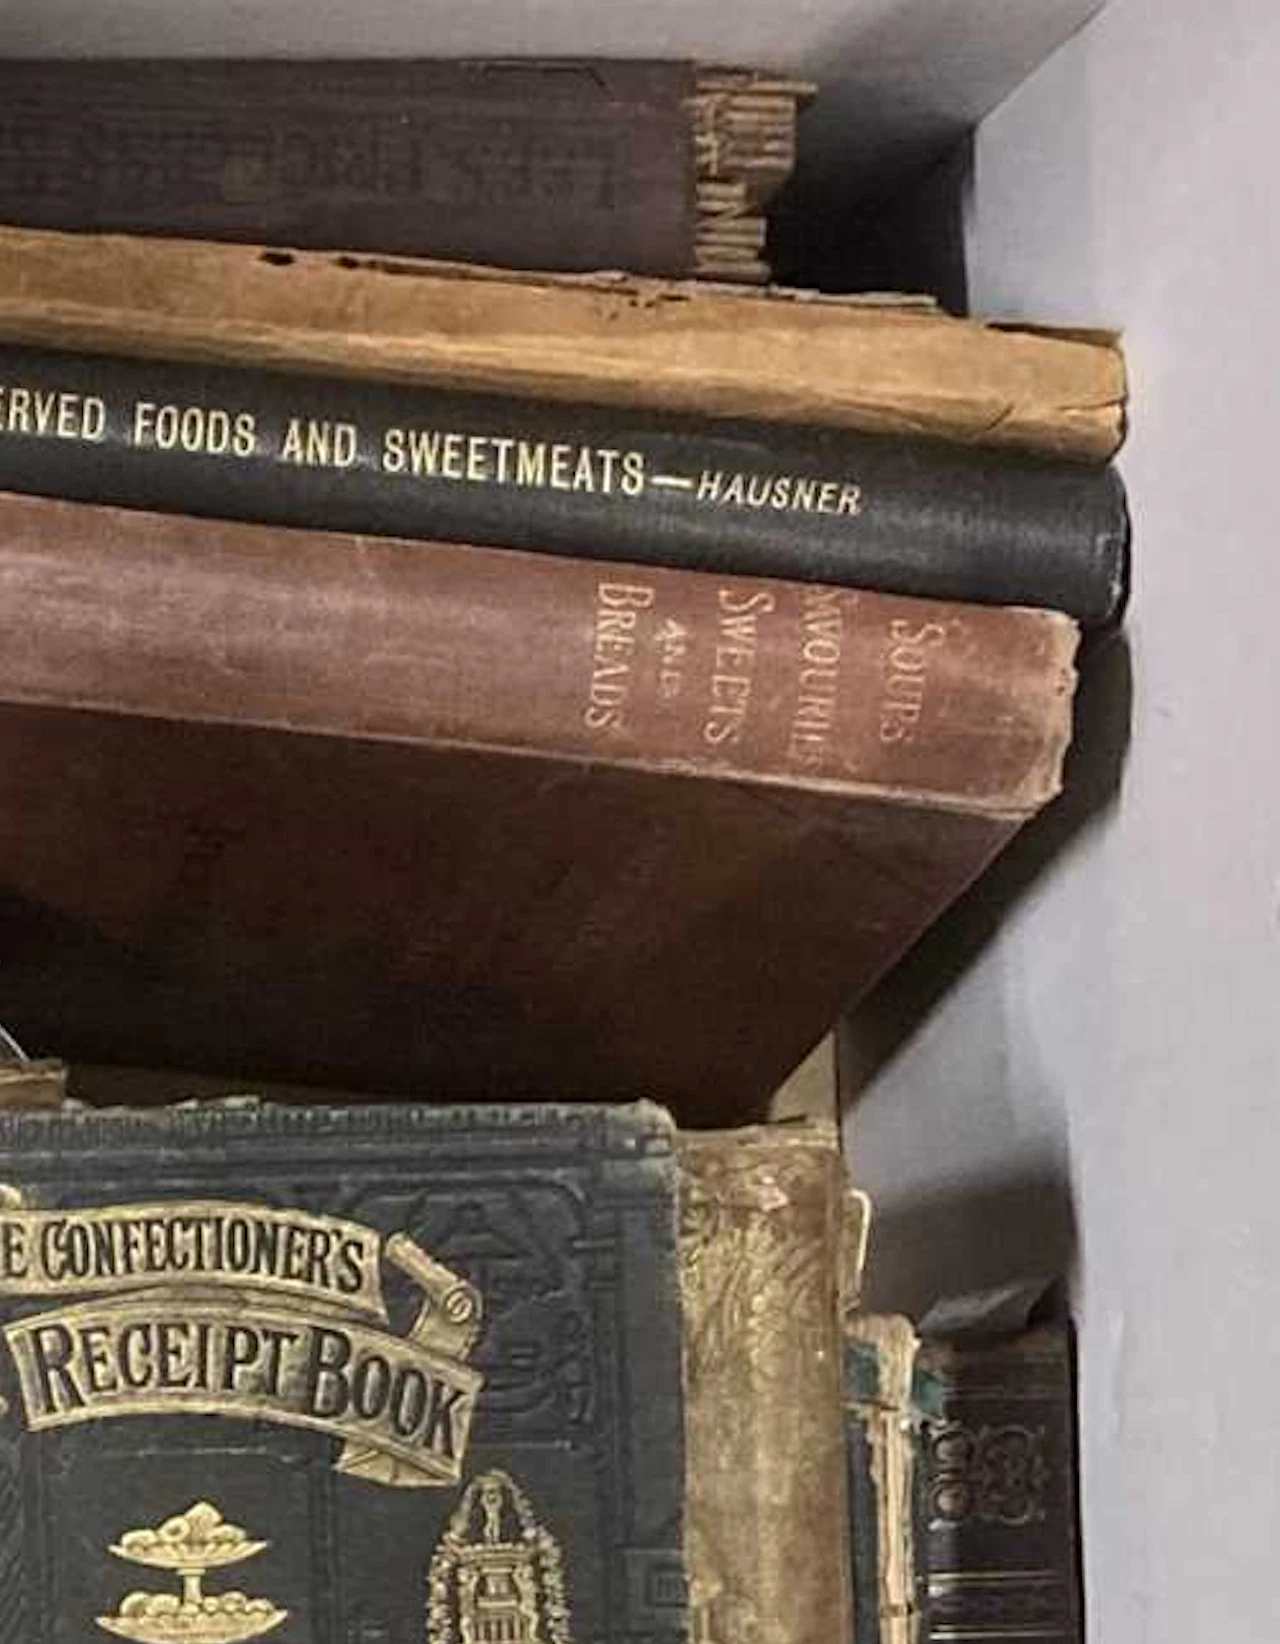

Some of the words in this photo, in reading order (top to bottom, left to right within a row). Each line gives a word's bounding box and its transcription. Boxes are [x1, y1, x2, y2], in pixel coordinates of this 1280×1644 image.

[132, 402, 257, 457] FOODS
[280, 418, 357, 468] AND
[582, 580, 655, 734] BREADS
[703, 587, 776, 746] SWEETS
[786, 586, 848, 776] AVOURIES
[879, 618, 946, 745] SOUPS
[42, 1215, 365, 1293] CONFECTIONER'S
[28, 1322, 297, 1415] RECEIPT
[306, 1325, 468, 1460] BOOK
